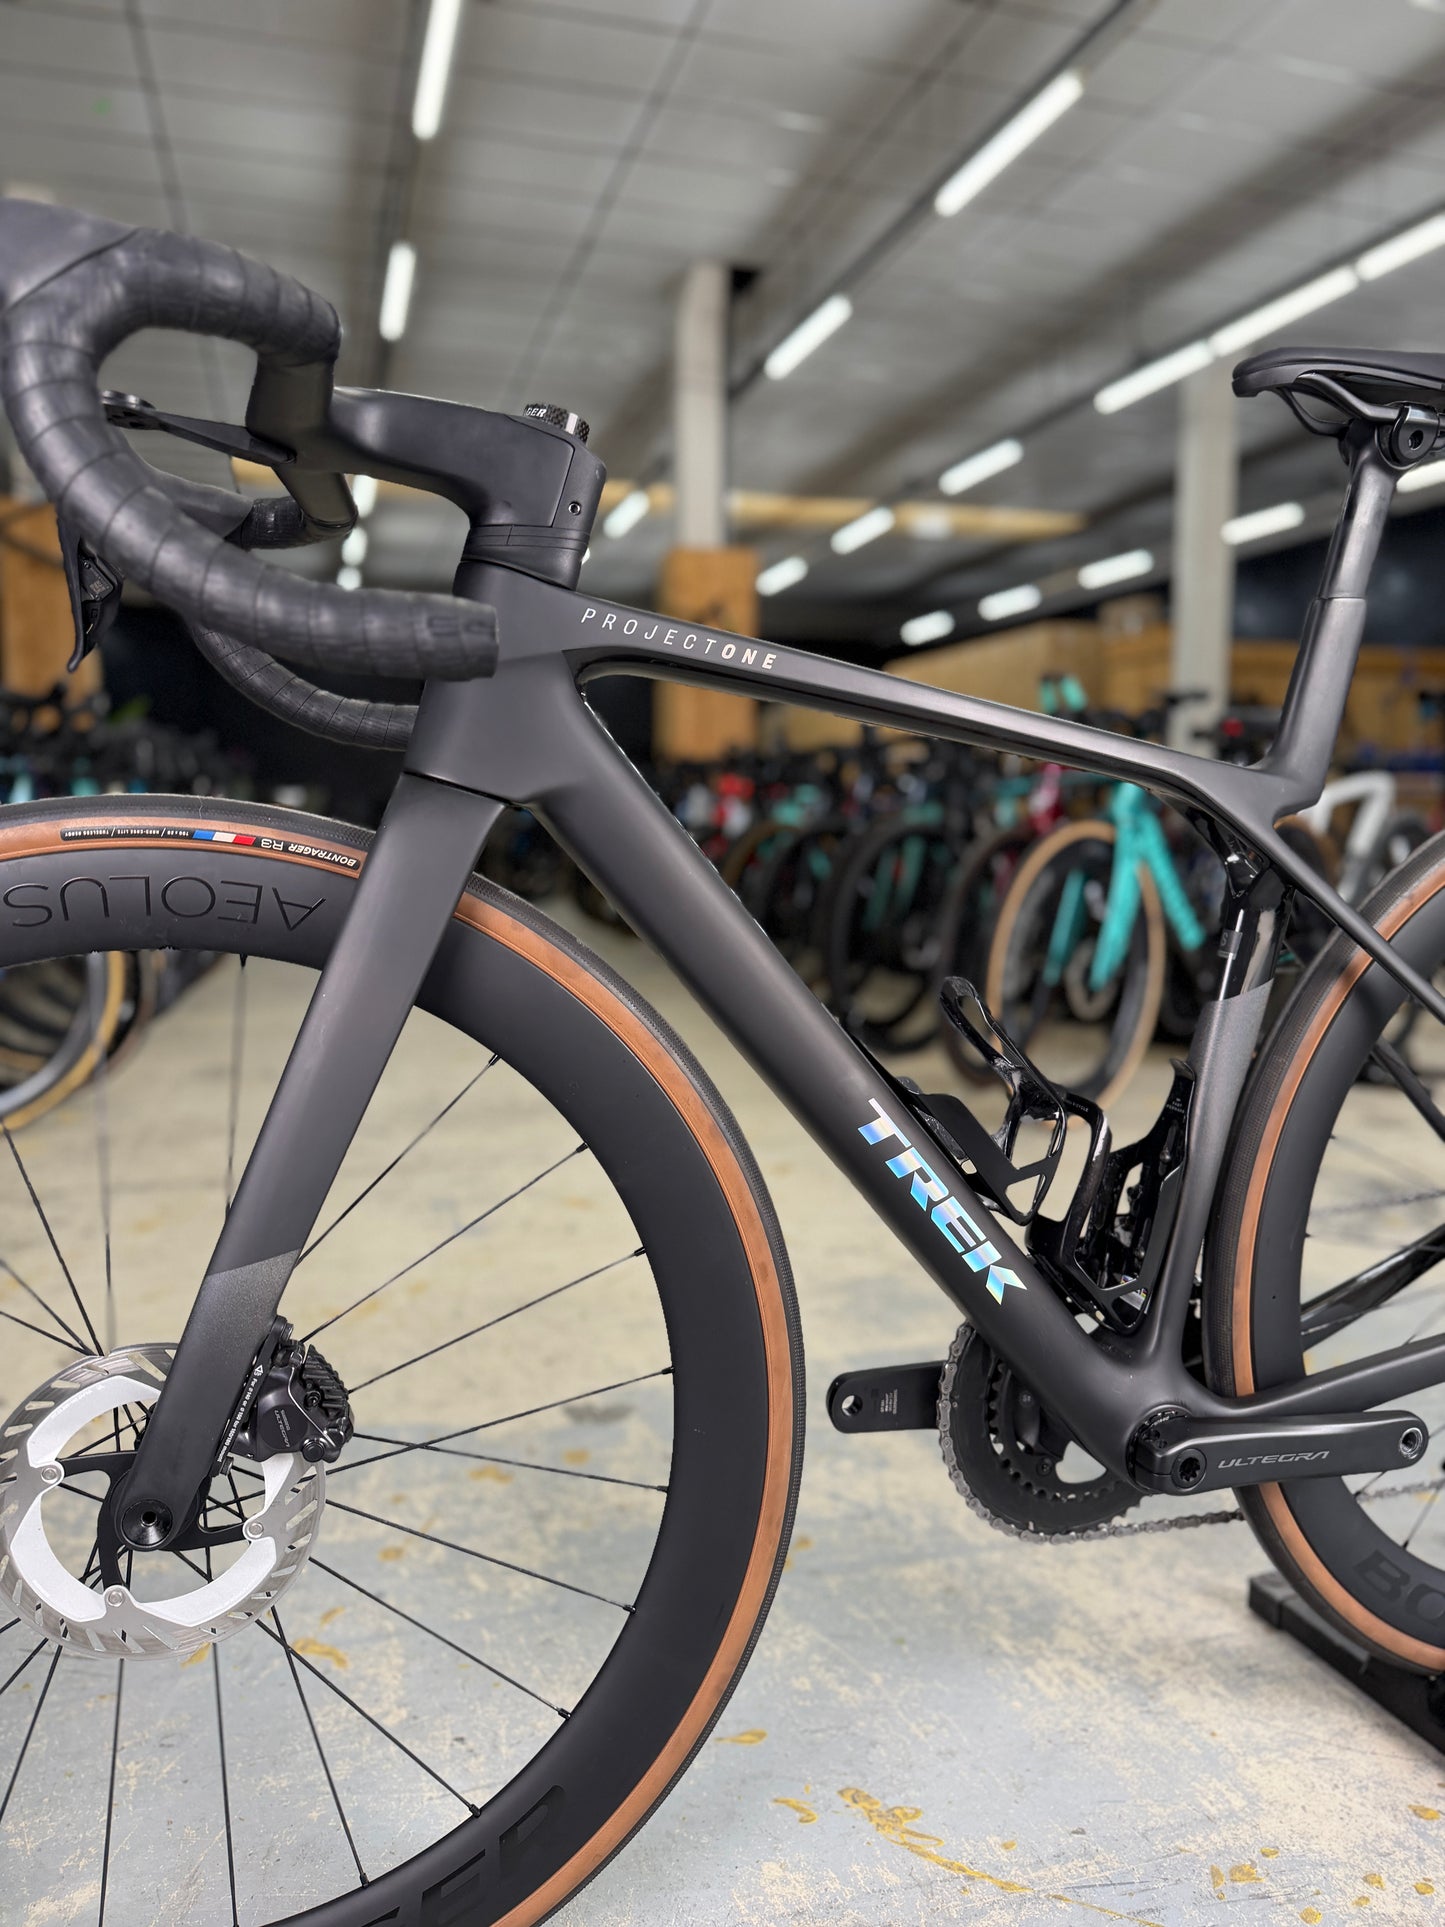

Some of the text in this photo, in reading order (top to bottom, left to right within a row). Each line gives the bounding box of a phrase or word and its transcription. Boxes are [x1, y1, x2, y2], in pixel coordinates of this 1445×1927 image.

[260, 838, 357, 867] BONTRAGER R3
[2, 874, 327, 931] AEOLUS
[858, 1098, 1028, 1305] TREK
[1218, 1450, 1330, 1469] ULTEGRA
